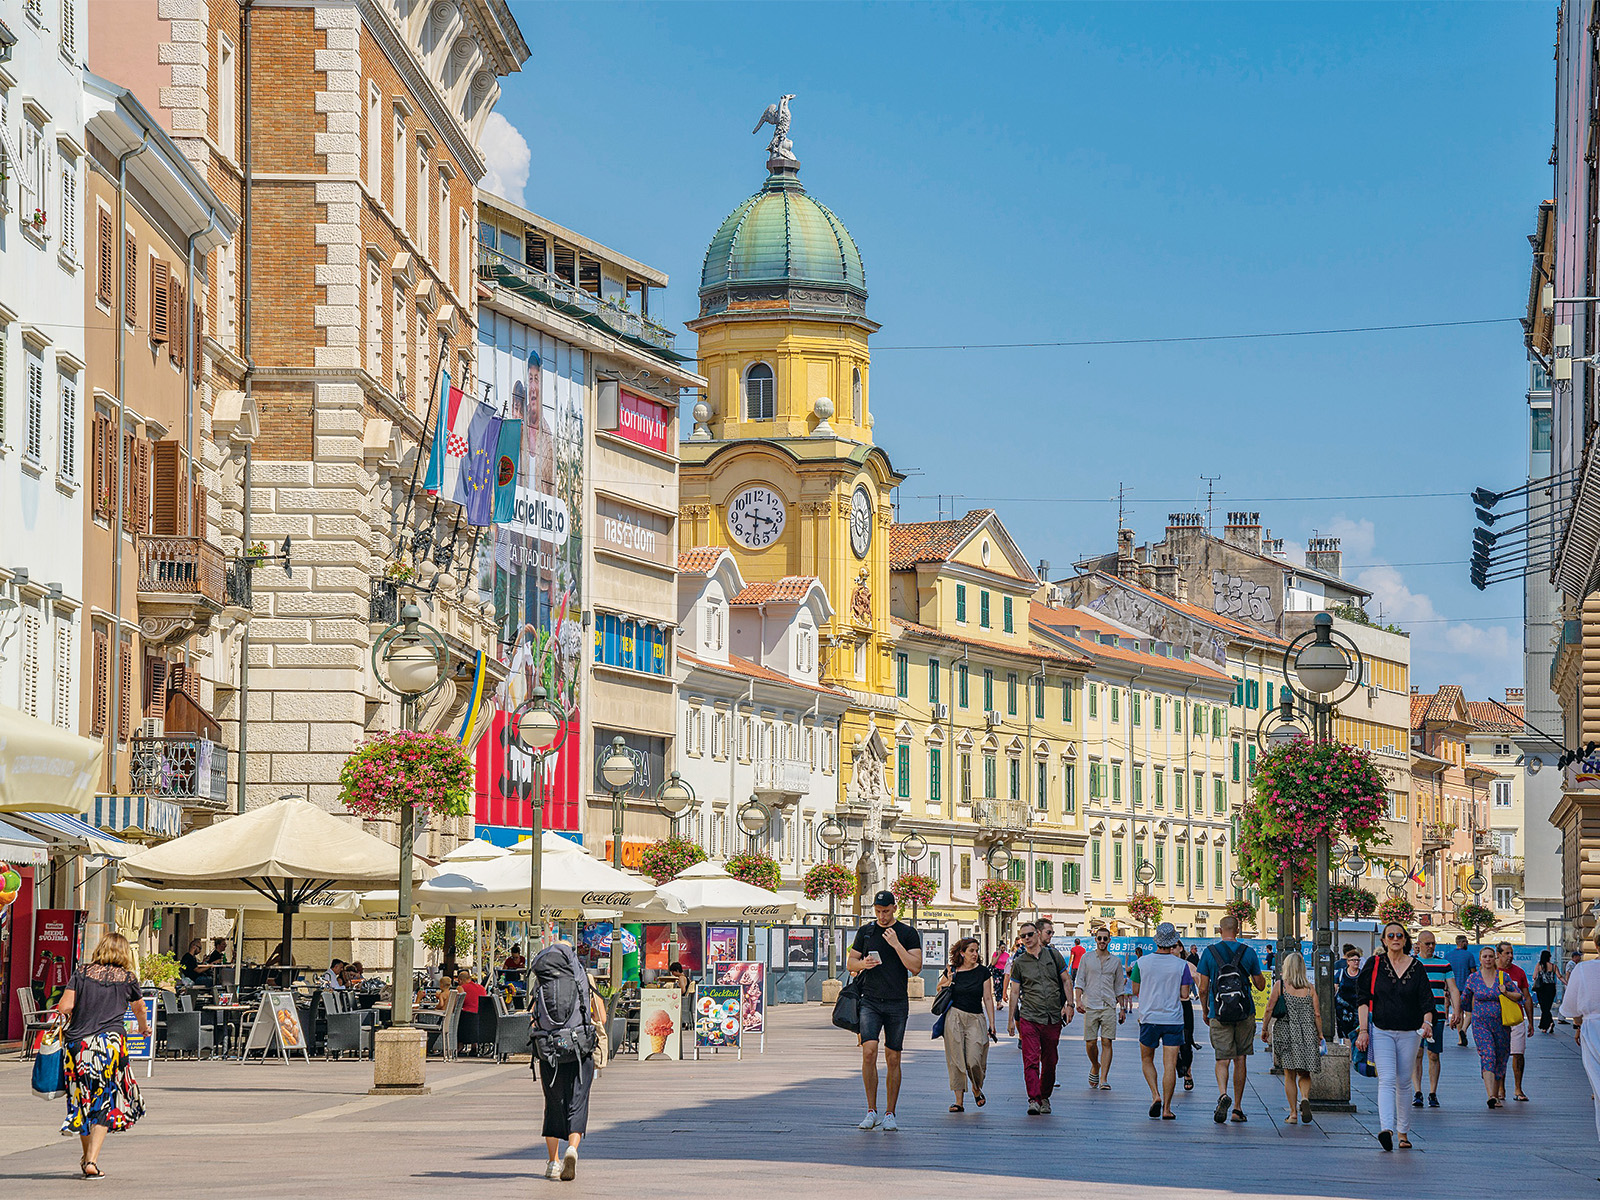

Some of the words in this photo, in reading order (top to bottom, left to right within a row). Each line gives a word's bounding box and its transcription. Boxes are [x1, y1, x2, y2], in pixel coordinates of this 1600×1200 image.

[620, 403, 666, 440] tommy.hr
[744, 493, 751, 504] 11
[754, 490, 764, 502] 12
[767, 493, 771, 505] 1
[735, 499, 745, 511] 10
[771, 499, 779, 511] 2
[731, 511, 739, 523] 9
[775, 511, 783, 523] 3
[735, 523, 743, 536] 8
[770, 523, 778, 534] 4
[634, 520, 656, 554] dom
[745, 532, 752, 543] 7
[753, 534, 760, 546] 6
[763, 531, 771, 543] 5
[1109, 943, 1121, 951] 98
[709, 988, 740, 998] Cocktail
